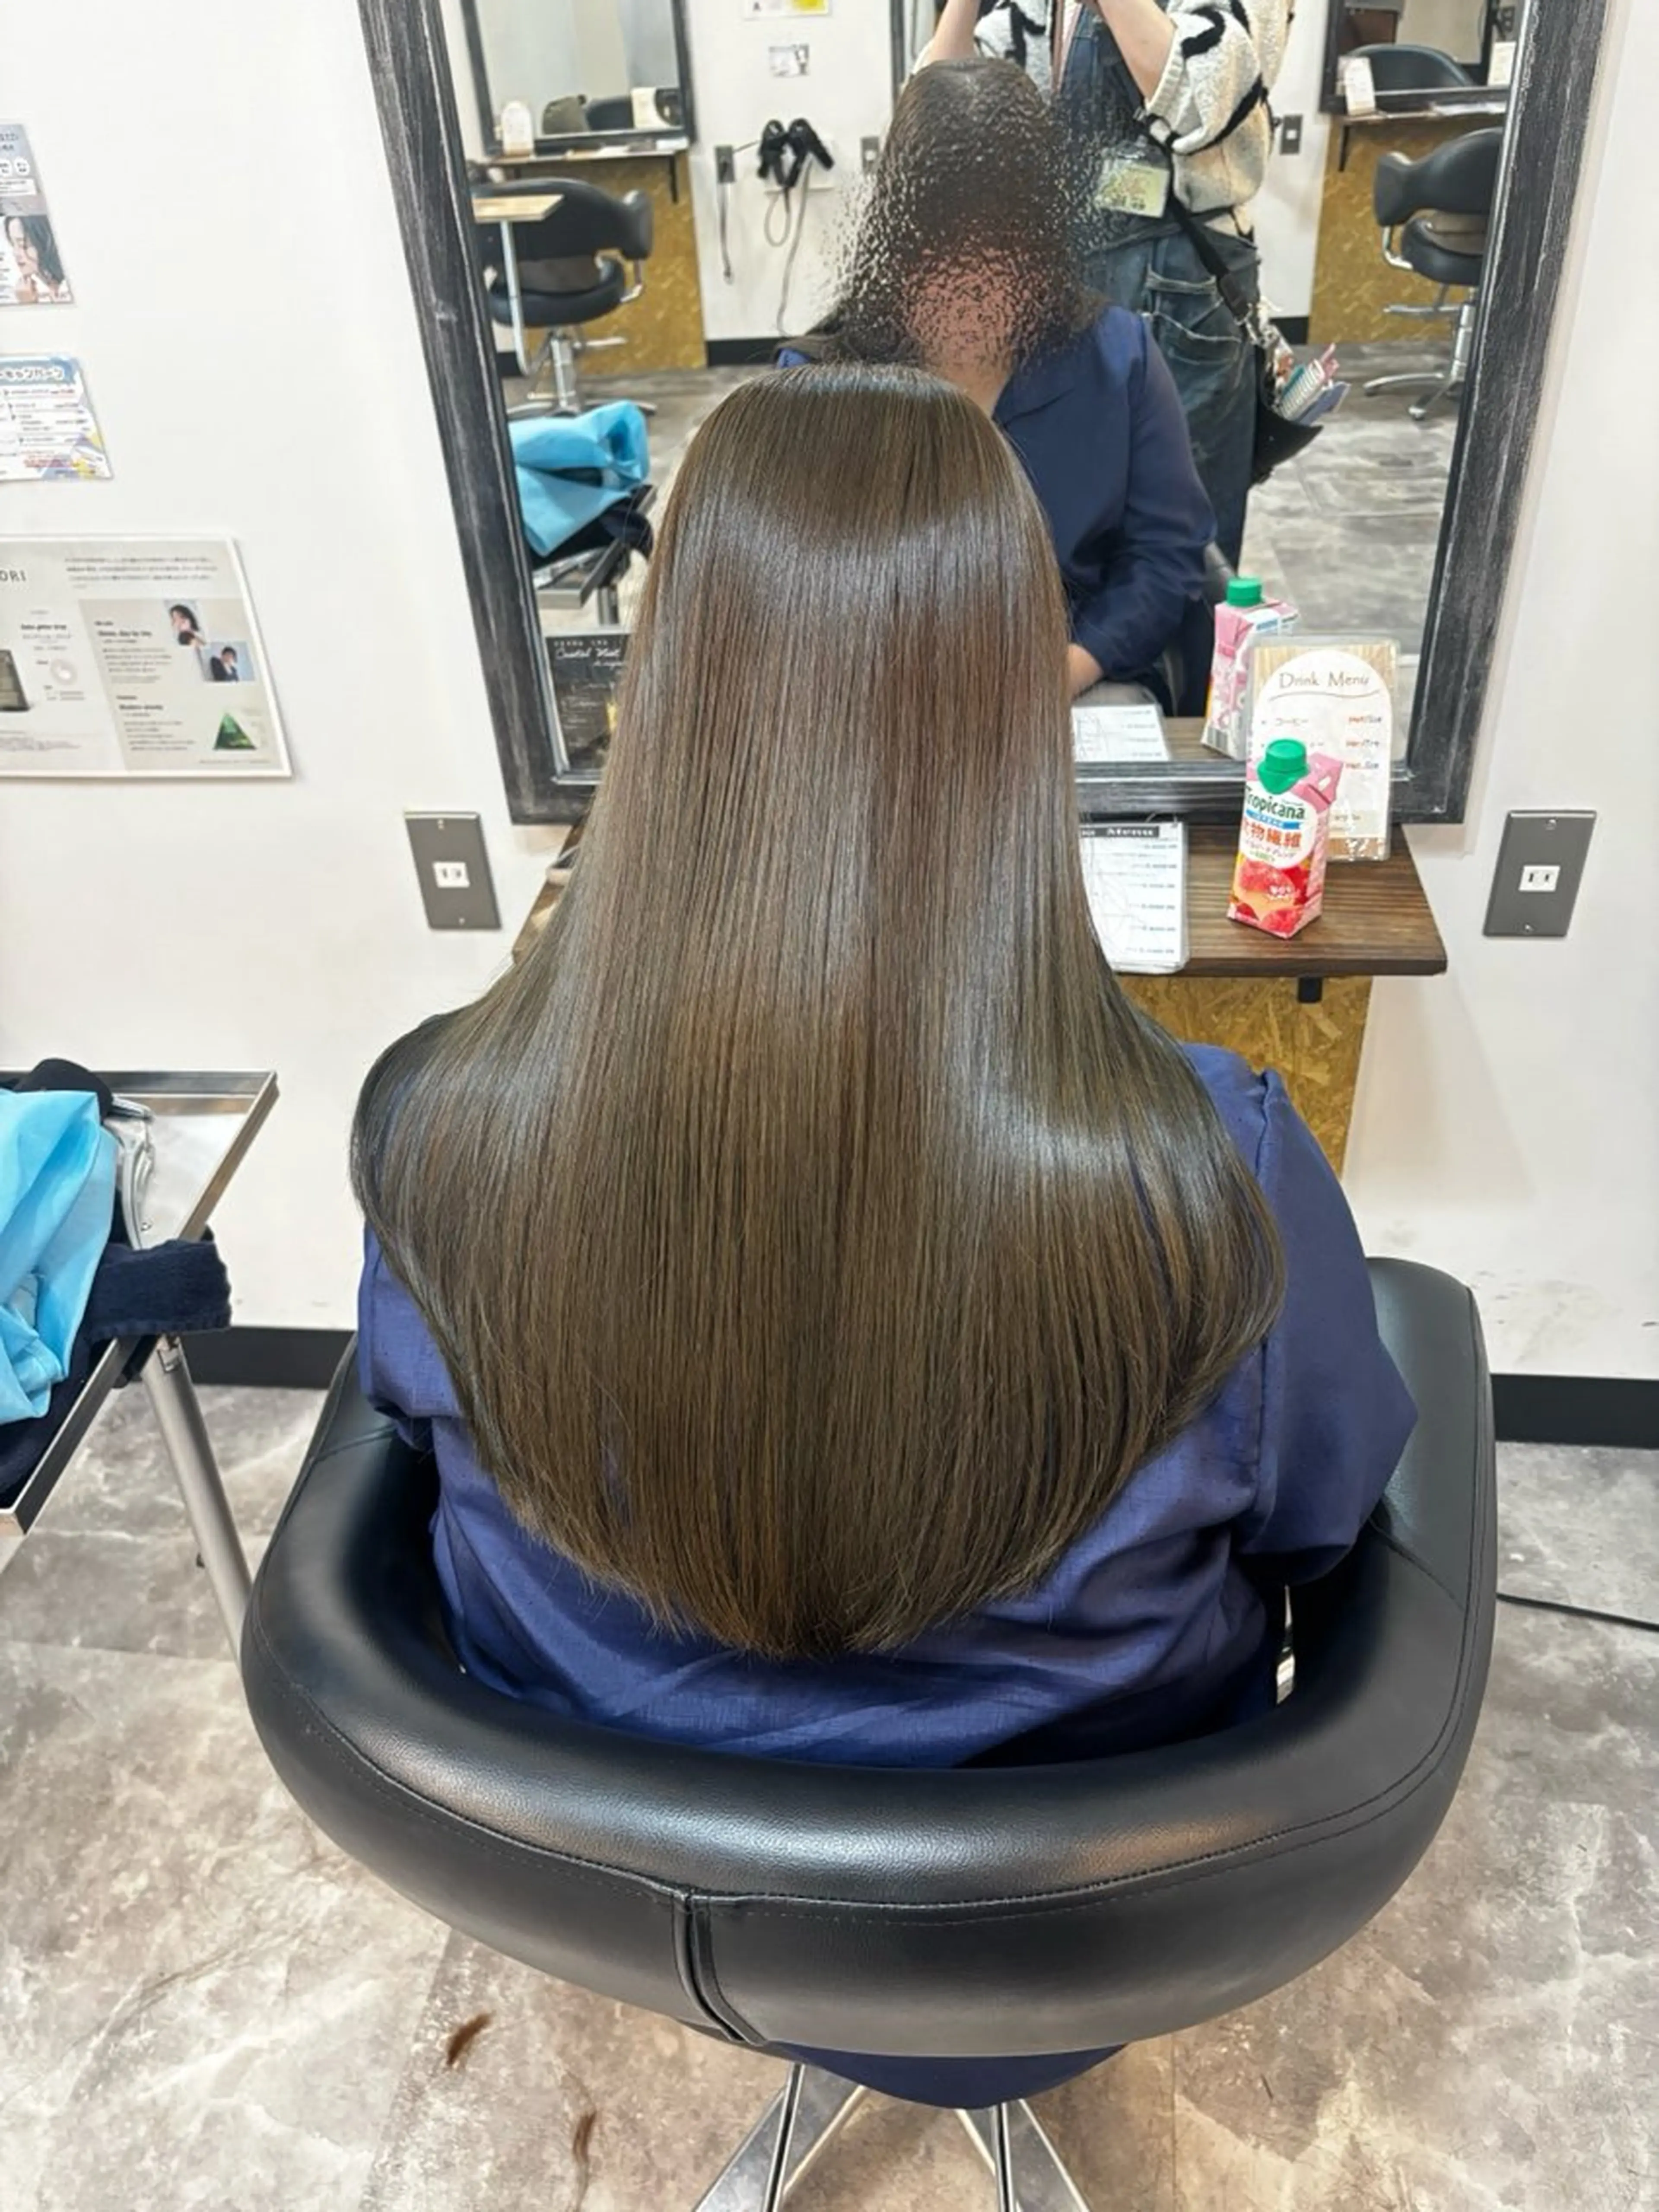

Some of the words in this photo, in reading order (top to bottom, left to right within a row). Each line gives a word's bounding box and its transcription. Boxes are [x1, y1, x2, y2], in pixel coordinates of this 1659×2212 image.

[1279, 671, 1319, 689] Drink
[1327, 671, 1370, 687] Menu
[1245, 785, 1306, 820] Tropicana
